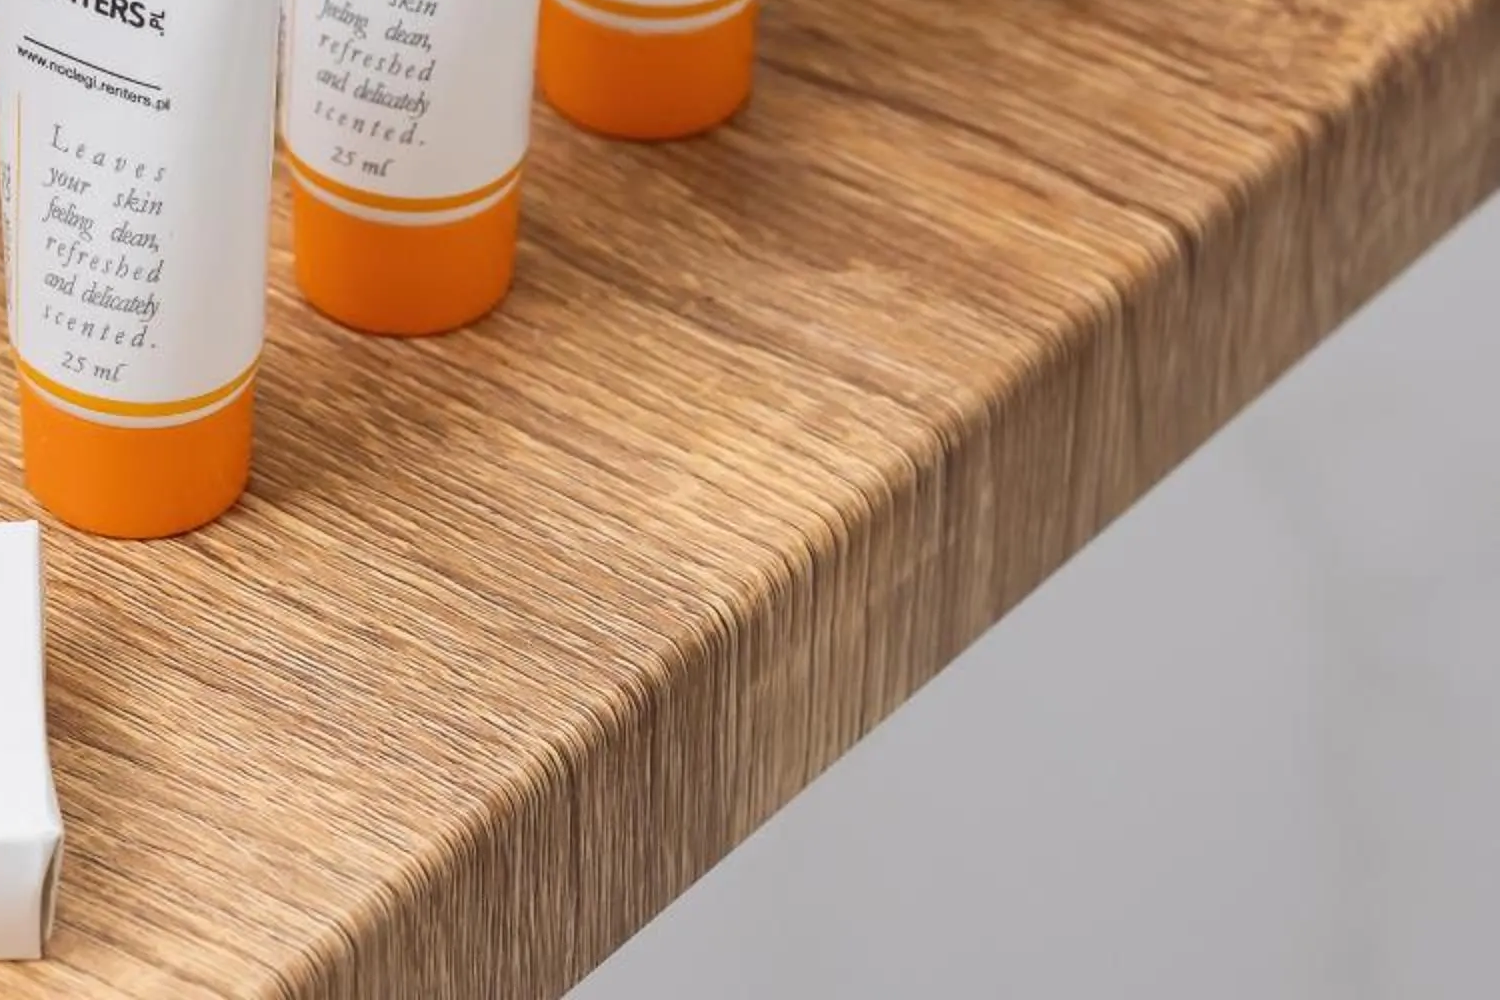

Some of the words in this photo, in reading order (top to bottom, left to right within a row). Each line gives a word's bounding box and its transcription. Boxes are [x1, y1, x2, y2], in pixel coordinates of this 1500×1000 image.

[17, 45, 170, 112] www.noclegi.renters.pl
[316, 65, 349, 93] and
[318, 33, 436, 83] refreshed
[314, 101, 426, 147] scented.
[52, 124, 166, 182] Leaves
[330, 146, 357, 166] 25
[42, 167, 92, 196] your
[113, 189, 163, 216] skin
[42, 196, 94, 242] feeling
[111, 222, 160, 253] clean,
[46, 235, 164, 284] refreshed
[44, 270, 77, 296] and
[81, 283, 161, 323] delicately
[43, 305, 156, 349] scented.
[62, 351, 86, 374] 25
[94, 361, 129, 383] ml
